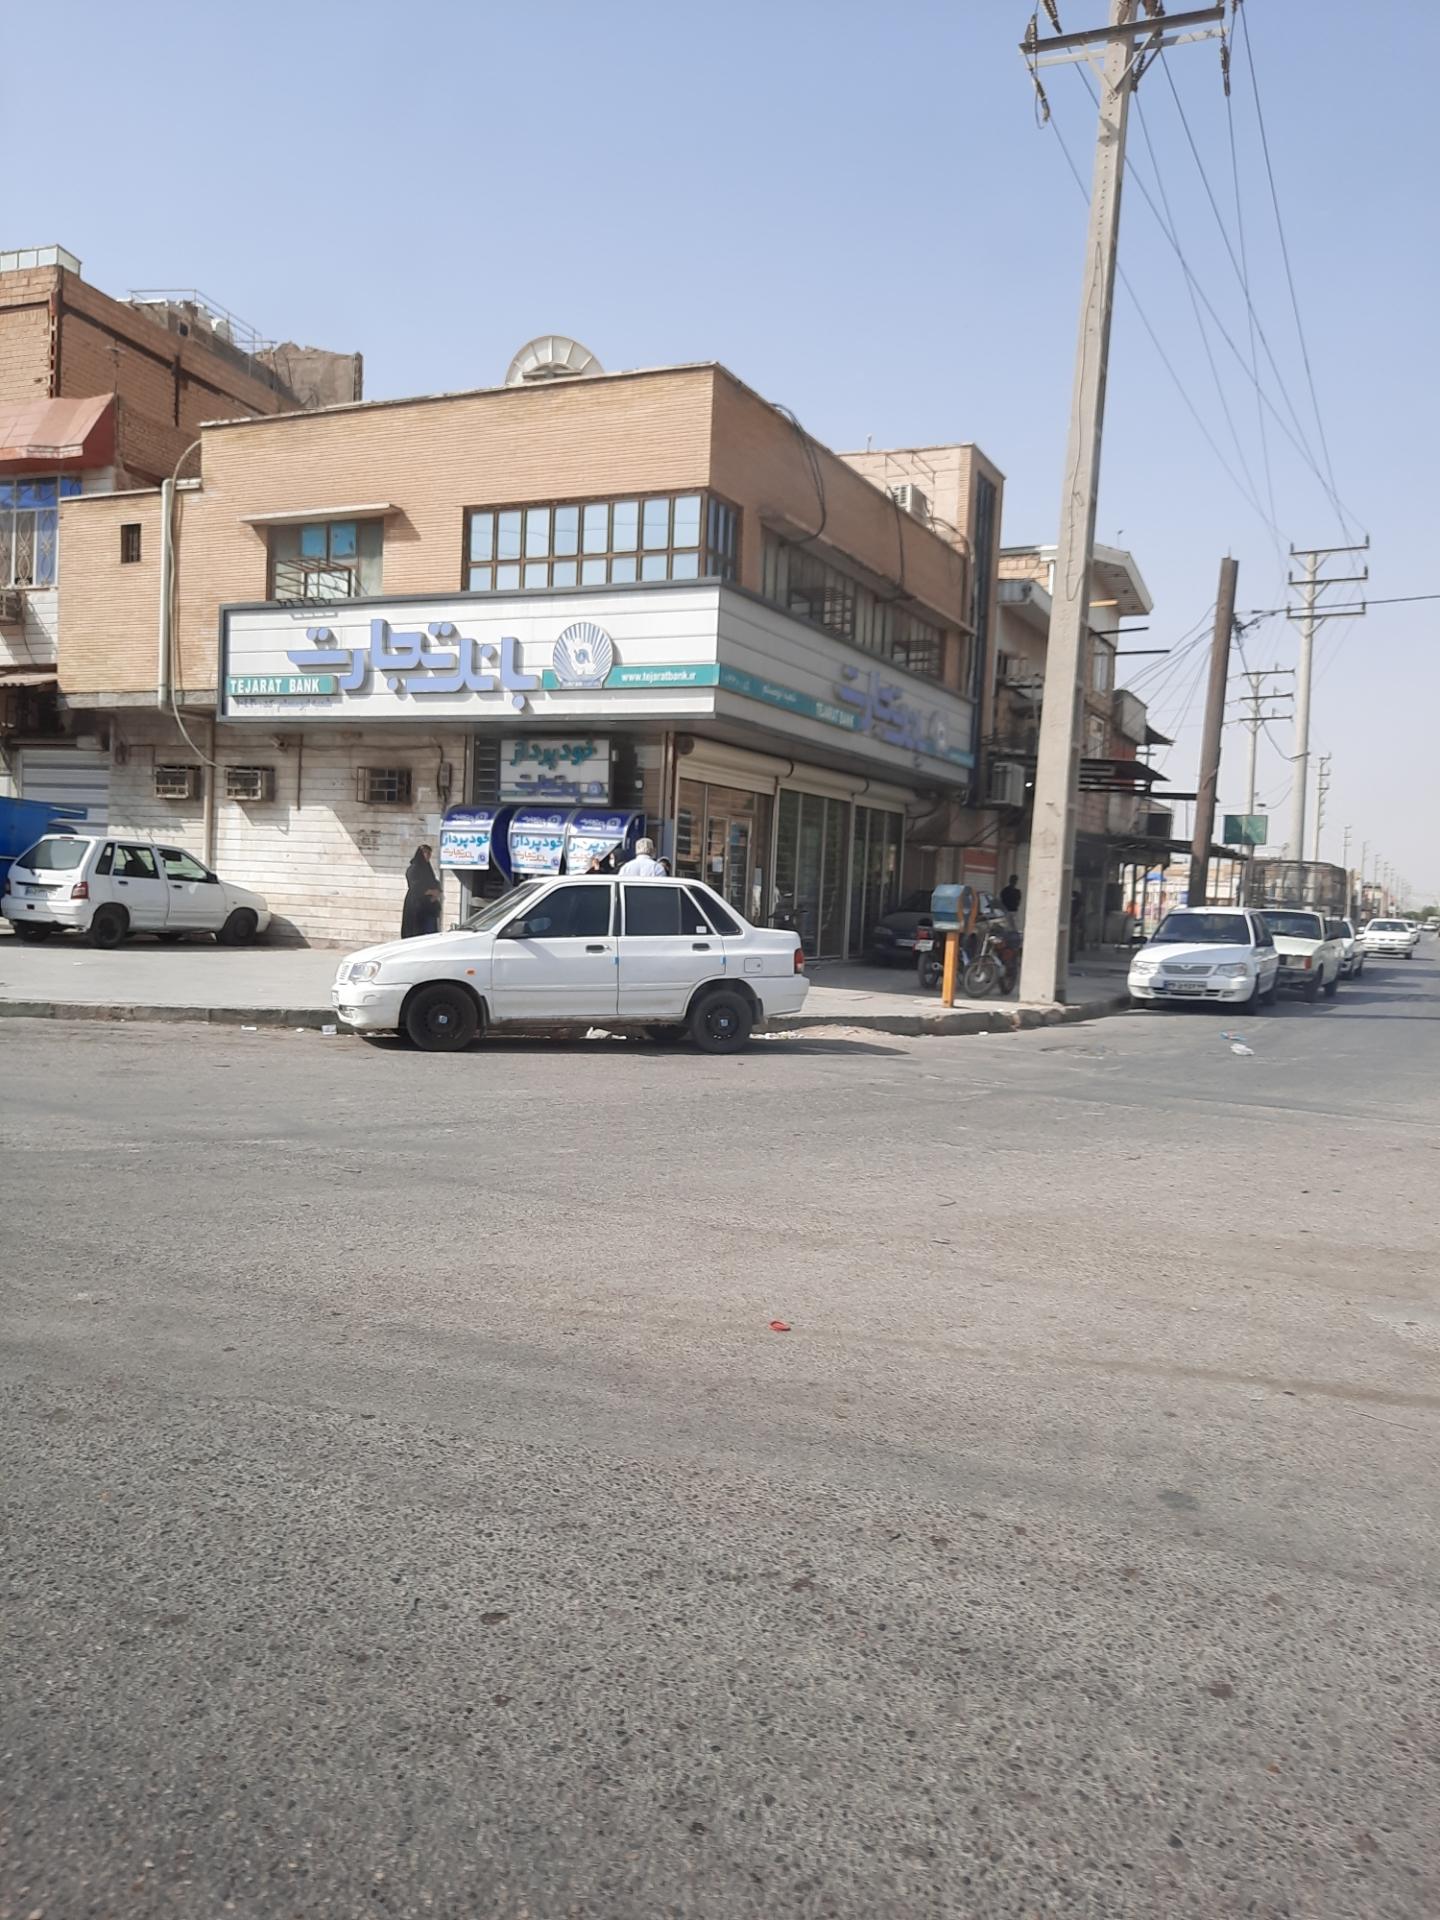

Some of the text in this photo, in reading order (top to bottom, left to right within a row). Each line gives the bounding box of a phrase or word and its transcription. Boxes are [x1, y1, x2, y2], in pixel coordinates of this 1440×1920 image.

[230, 678, 320, 694] TEJARAT BANK
[287, 619, 540, 710] بانک تجارت
